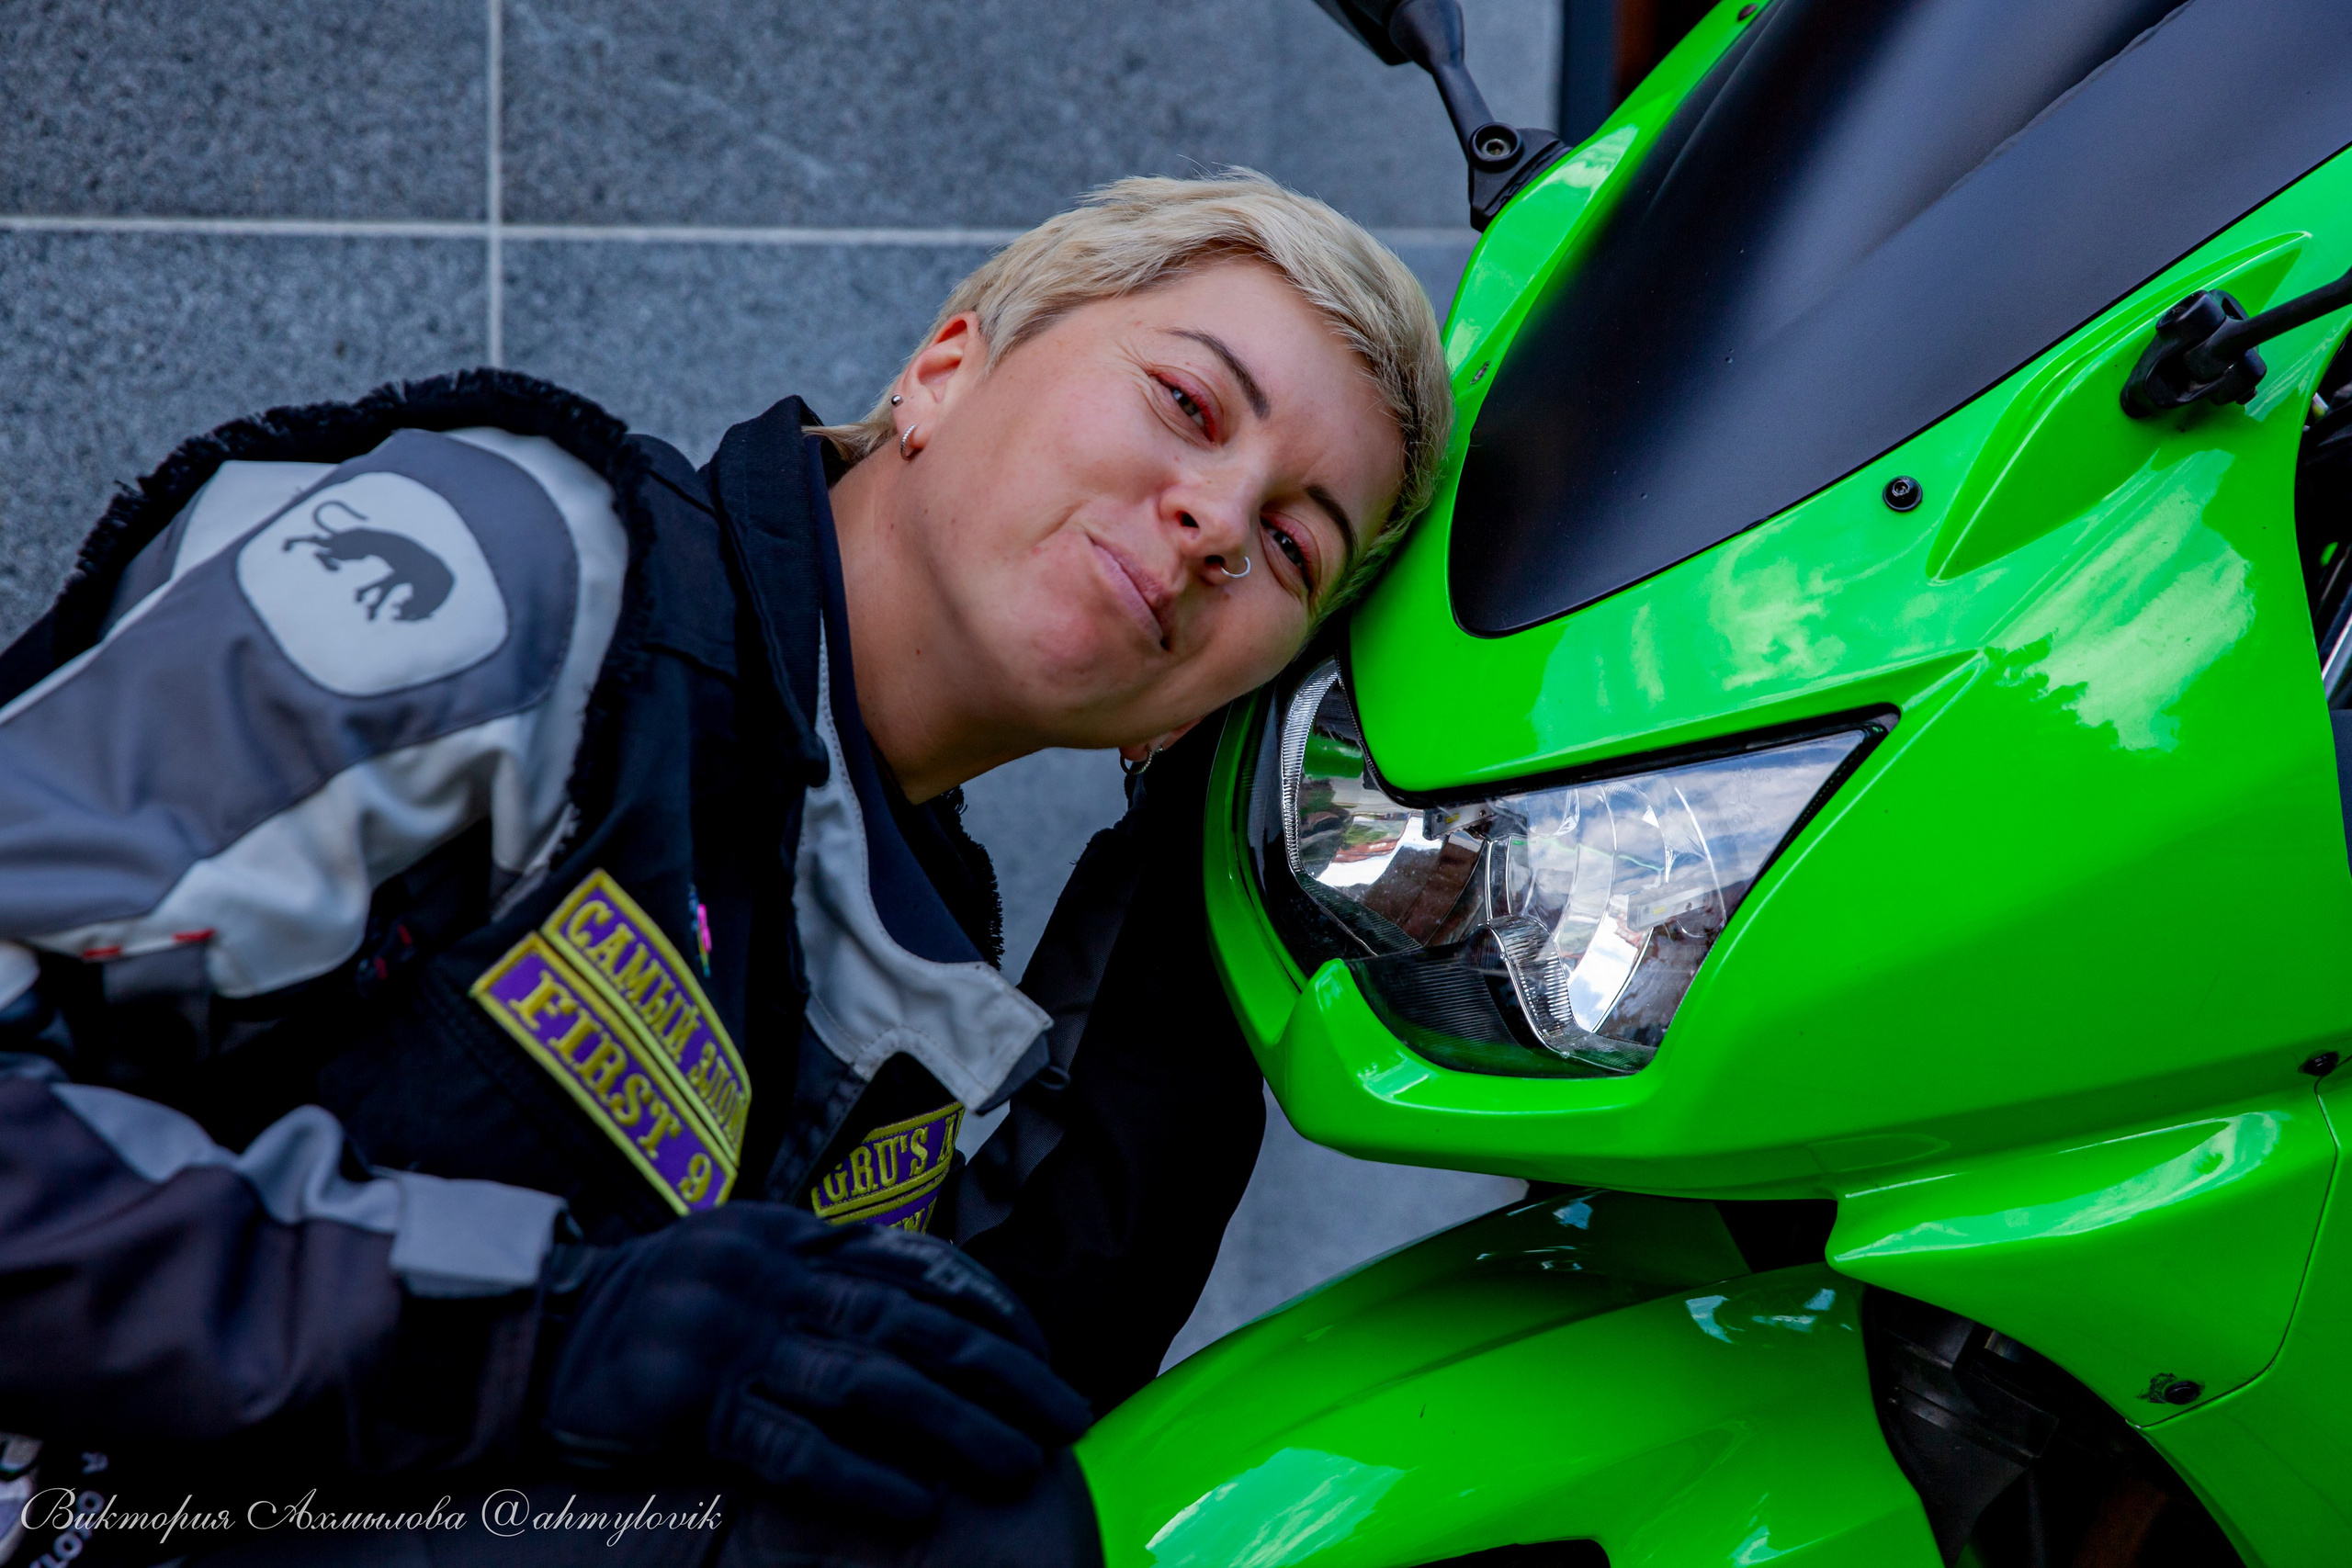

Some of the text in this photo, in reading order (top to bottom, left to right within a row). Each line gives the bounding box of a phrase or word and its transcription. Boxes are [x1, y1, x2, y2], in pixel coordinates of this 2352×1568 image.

[507, 969, 713, 1202] FIRST 9
[822, 1126, 929, 1203] GRU'S
